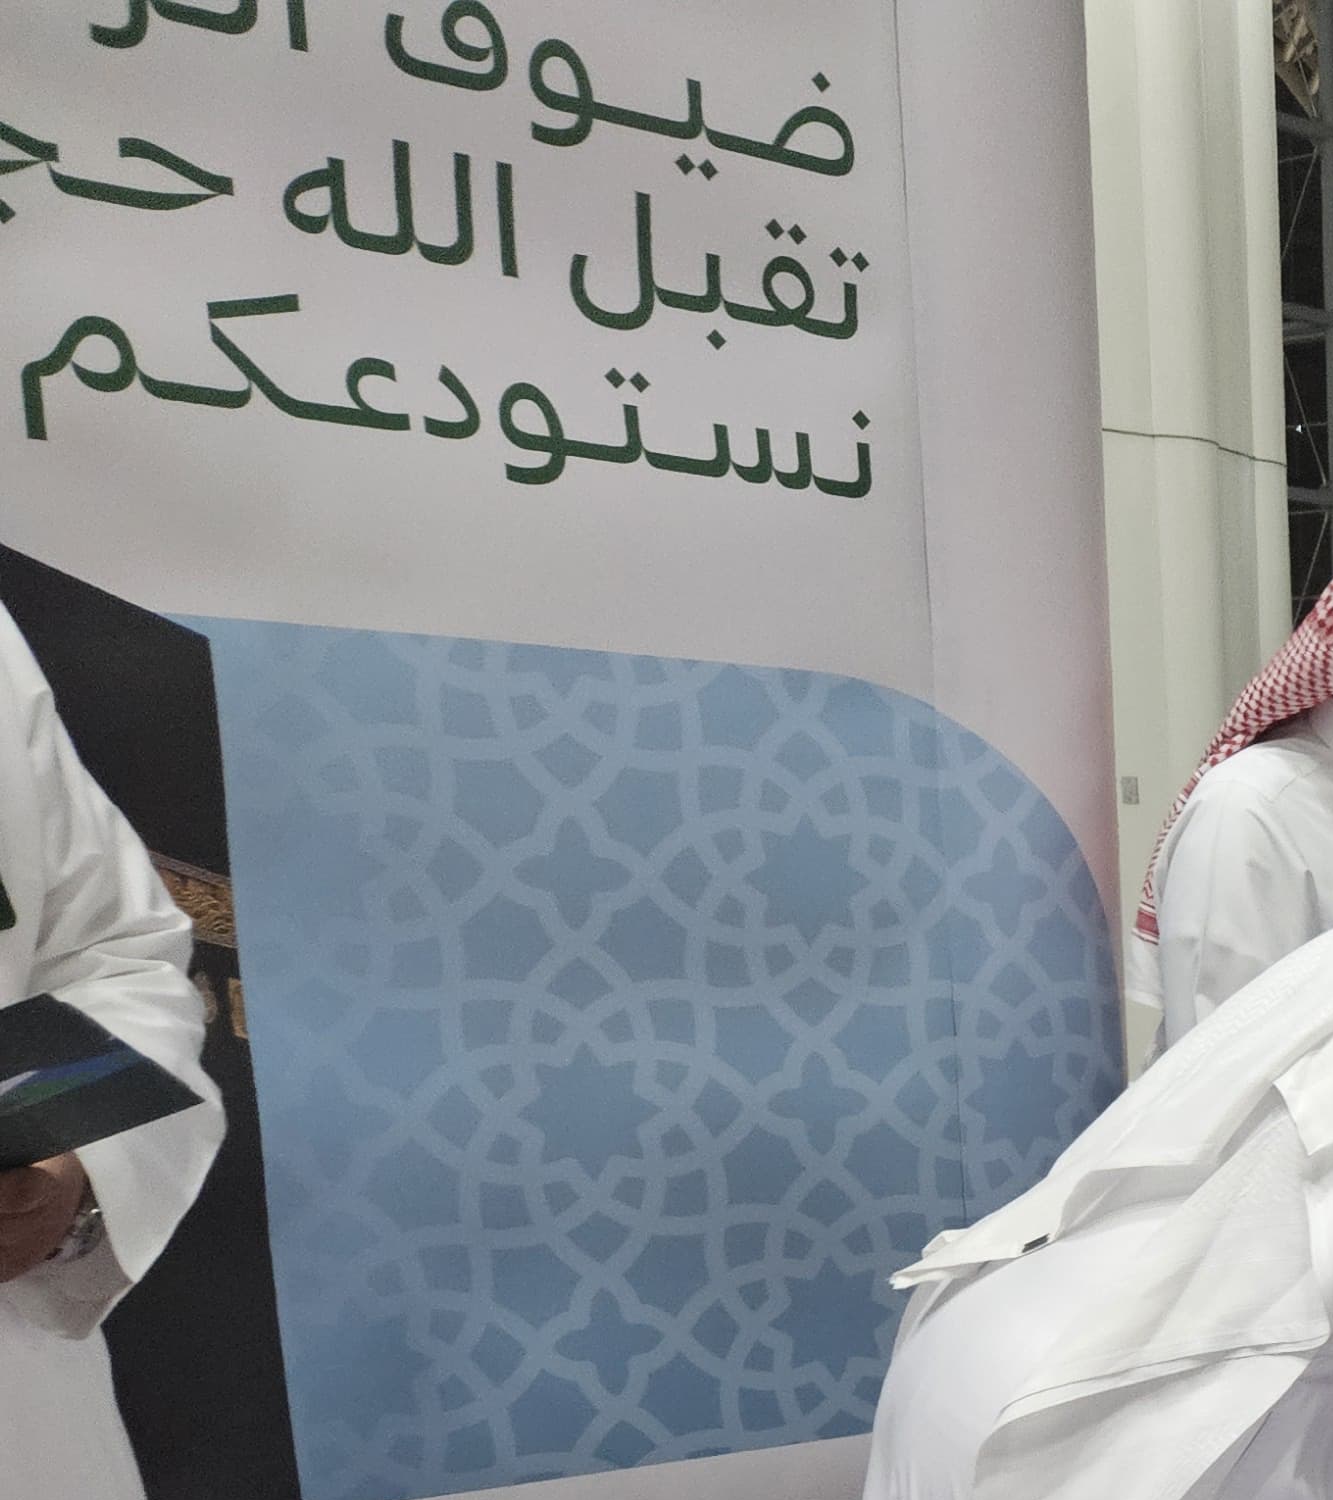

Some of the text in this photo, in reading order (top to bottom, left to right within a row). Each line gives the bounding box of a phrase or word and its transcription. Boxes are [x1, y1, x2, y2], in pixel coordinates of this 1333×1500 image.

[282, 139, 519, 279] الله
[569, 191, 870, 350] تقبل
[20, 293, 873, 499] نستودعكم
